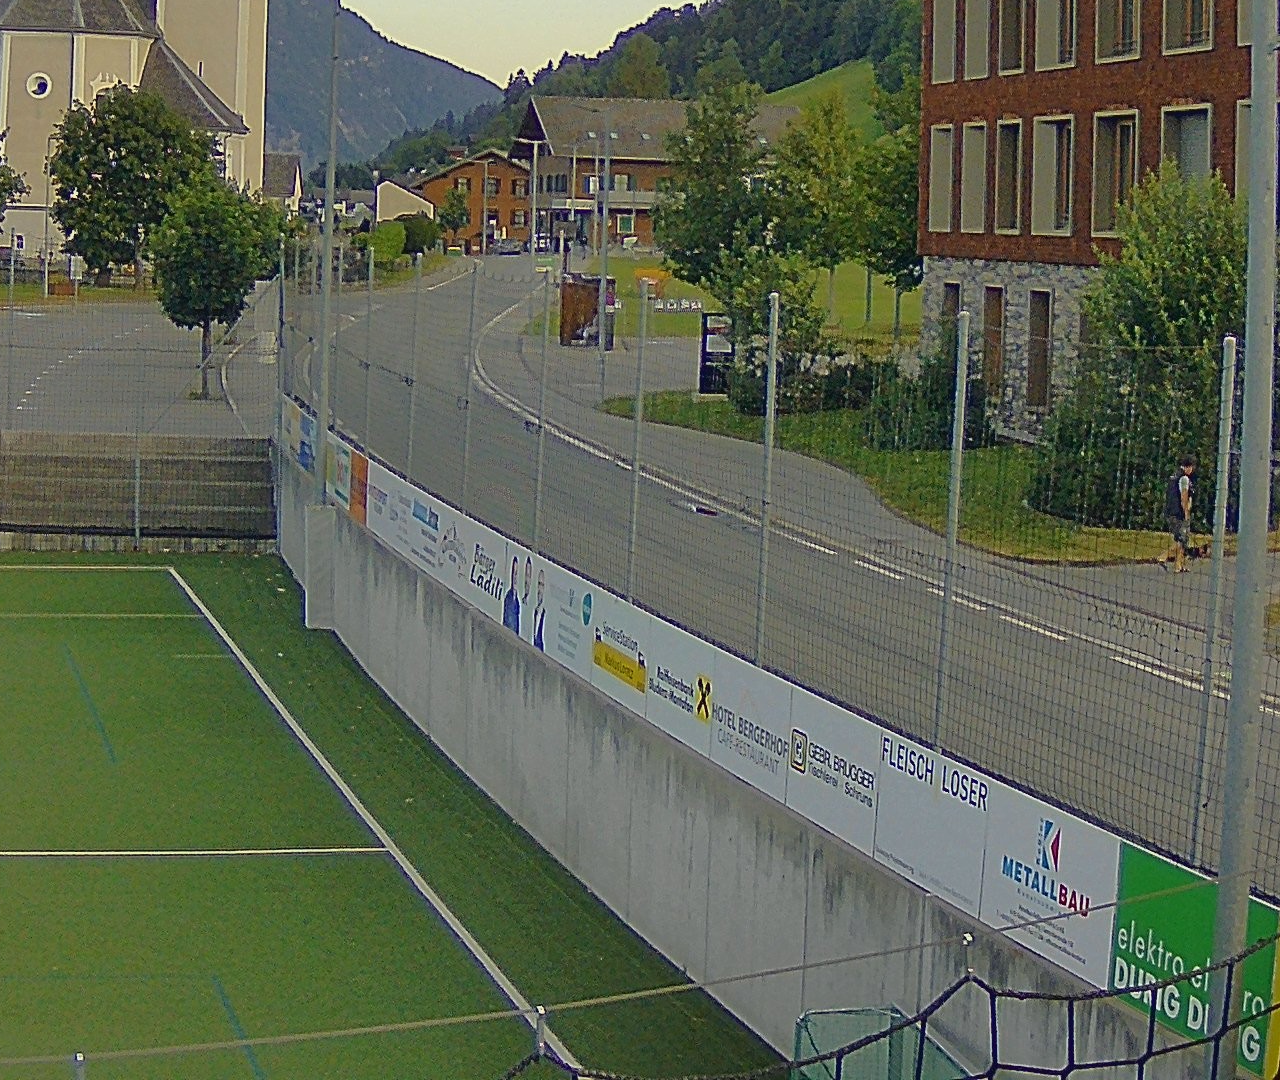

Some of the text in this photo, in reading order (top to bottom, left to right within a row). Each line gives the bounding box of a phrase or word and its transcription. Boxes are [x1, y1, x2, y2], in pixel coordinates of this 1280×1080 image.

[712, 702, 789, 758] HOTEL BERGERHOF
[882, 736, 988, 811] FLEISCH LOSER
[1002, 855, 1090, 917] METALLBAU
[1118, 920, 1184, 975] elektro
